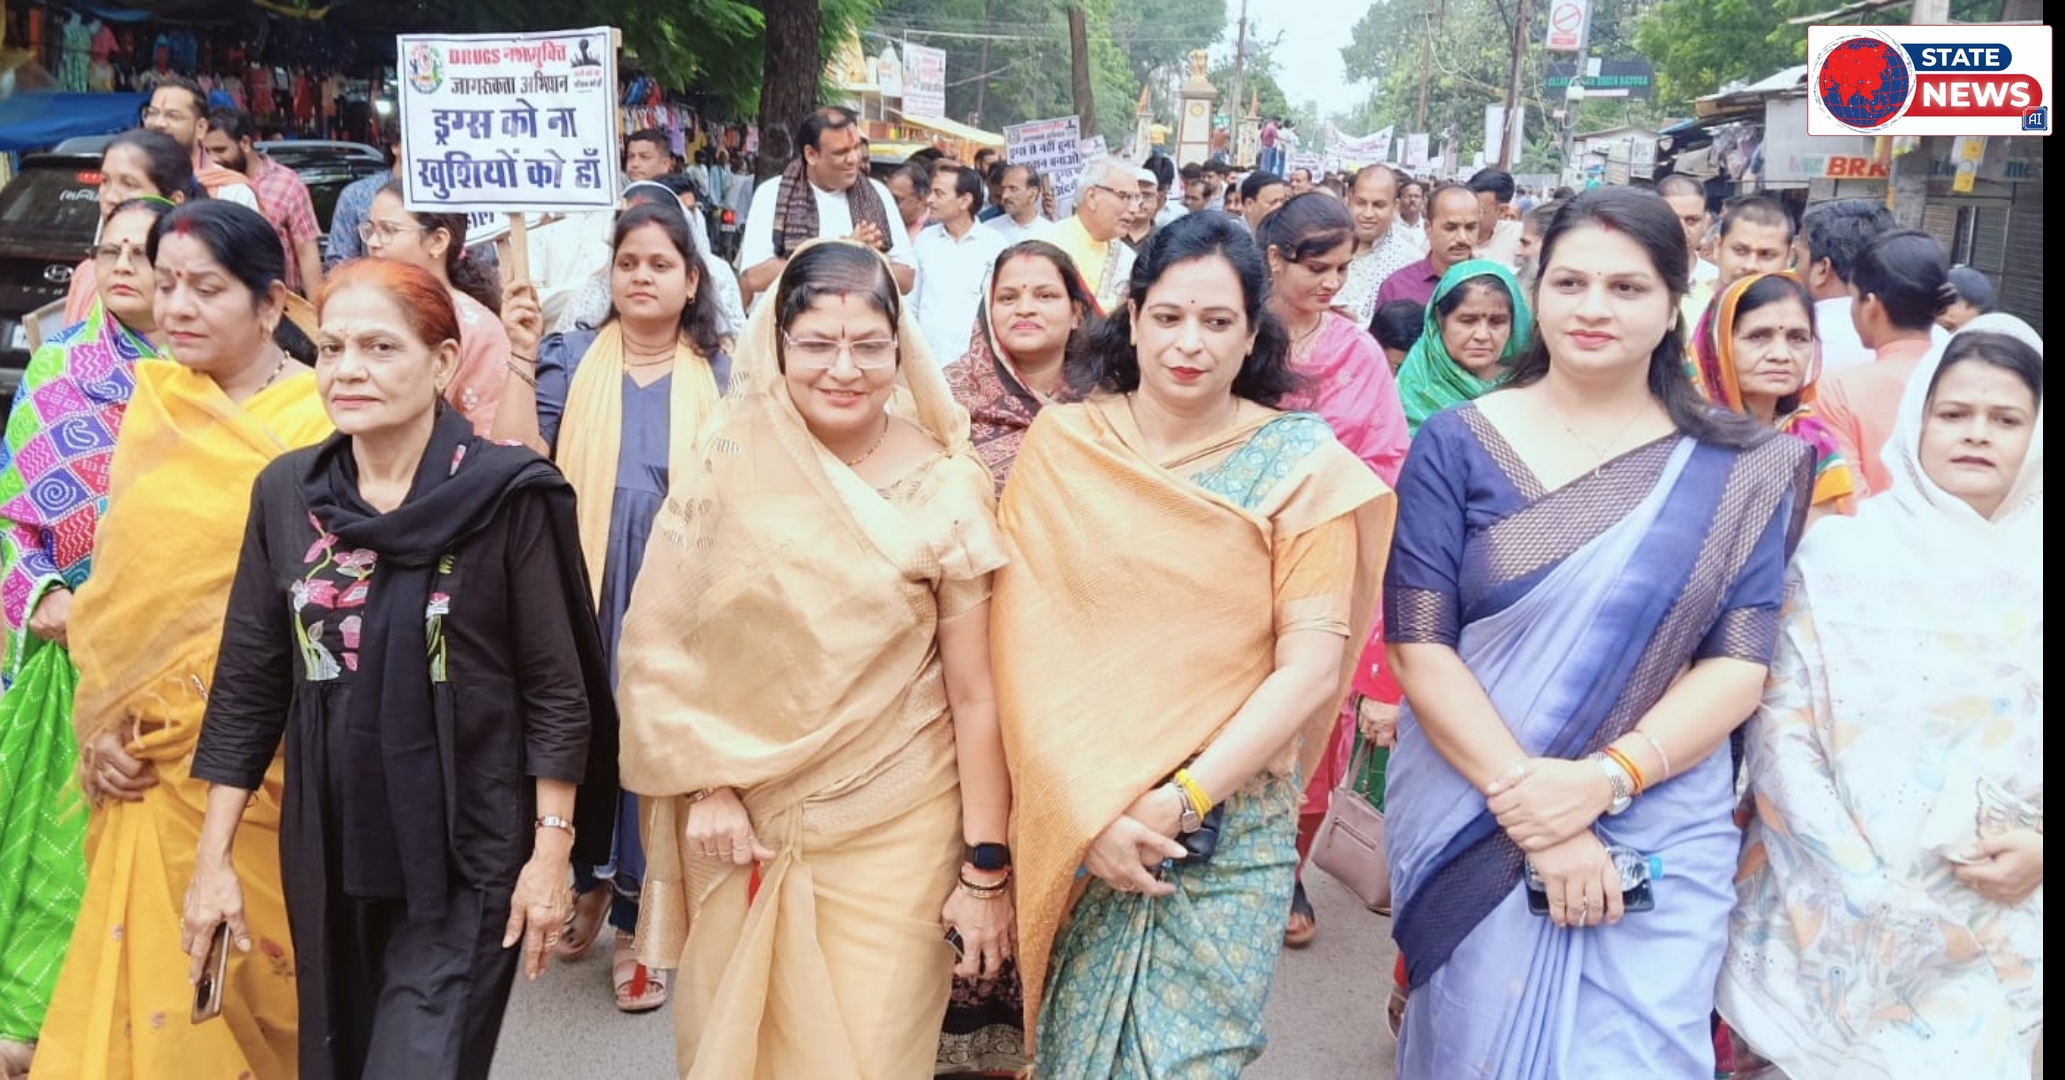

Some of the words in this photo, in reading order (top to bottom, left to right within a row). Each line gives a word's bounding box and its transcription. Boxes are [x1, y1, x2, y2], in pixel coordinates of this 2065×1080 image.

[449, 48, 501, 65] DRUGS
[520, 70, 569, 94] अभियान
[431, 107, 495, 146] ड्रग्स
[500, 98, 539, 138] को
[546, 106, 578, 138] ना
[416, 149, 519, 200] खुशियों
[523, 148, 567, 190] को
[573, 147, 602, 190] हाँ
